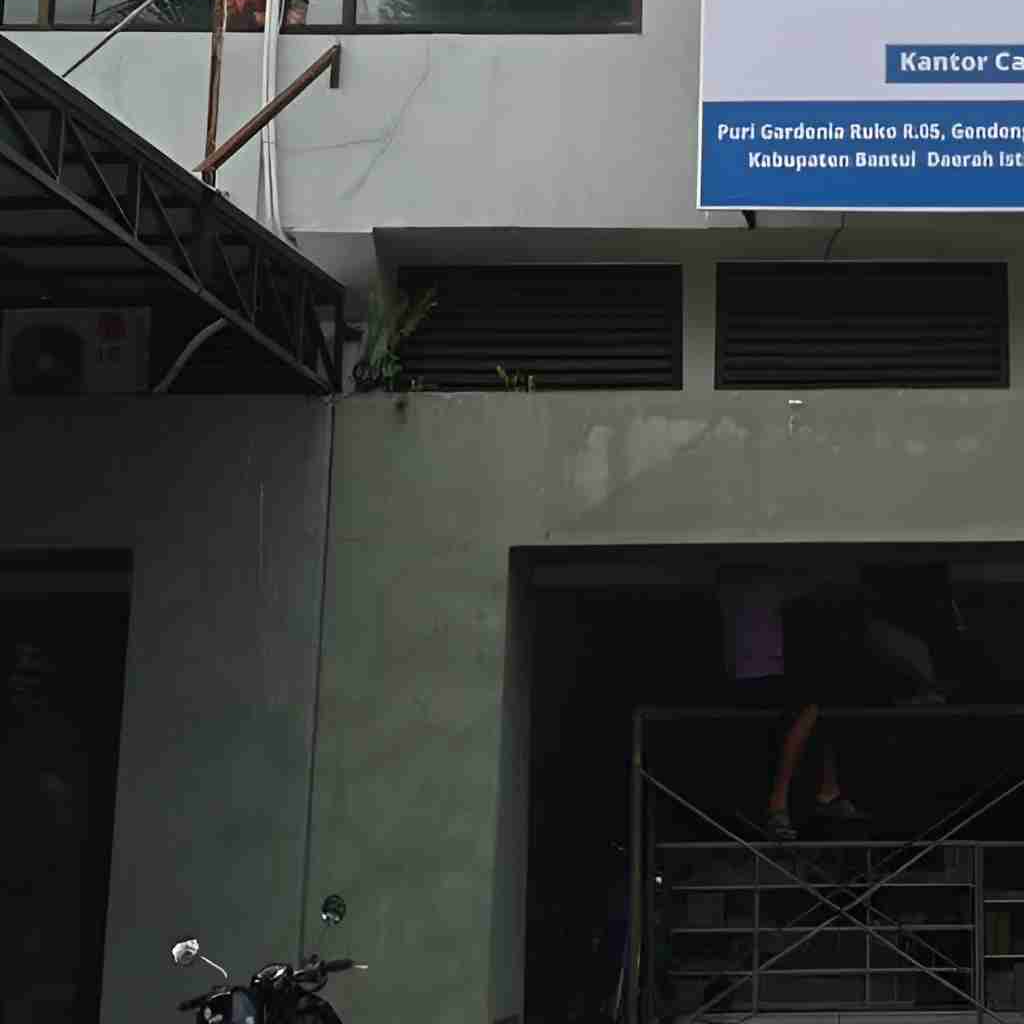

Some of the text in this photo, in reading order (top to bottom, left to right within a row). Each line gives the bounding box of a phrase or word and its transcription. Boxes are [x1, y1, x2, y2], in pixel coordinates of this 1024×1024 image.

[900, 51, 988, 72] Kantor
[717, 123, 755, 140] Puri
[850, 123, 896, 139] Ruko
[903, 123, 945, 141] R.05,
[748, 151, 849, 172] Kabupaten
[855, 150, 916, 168] Bantul
